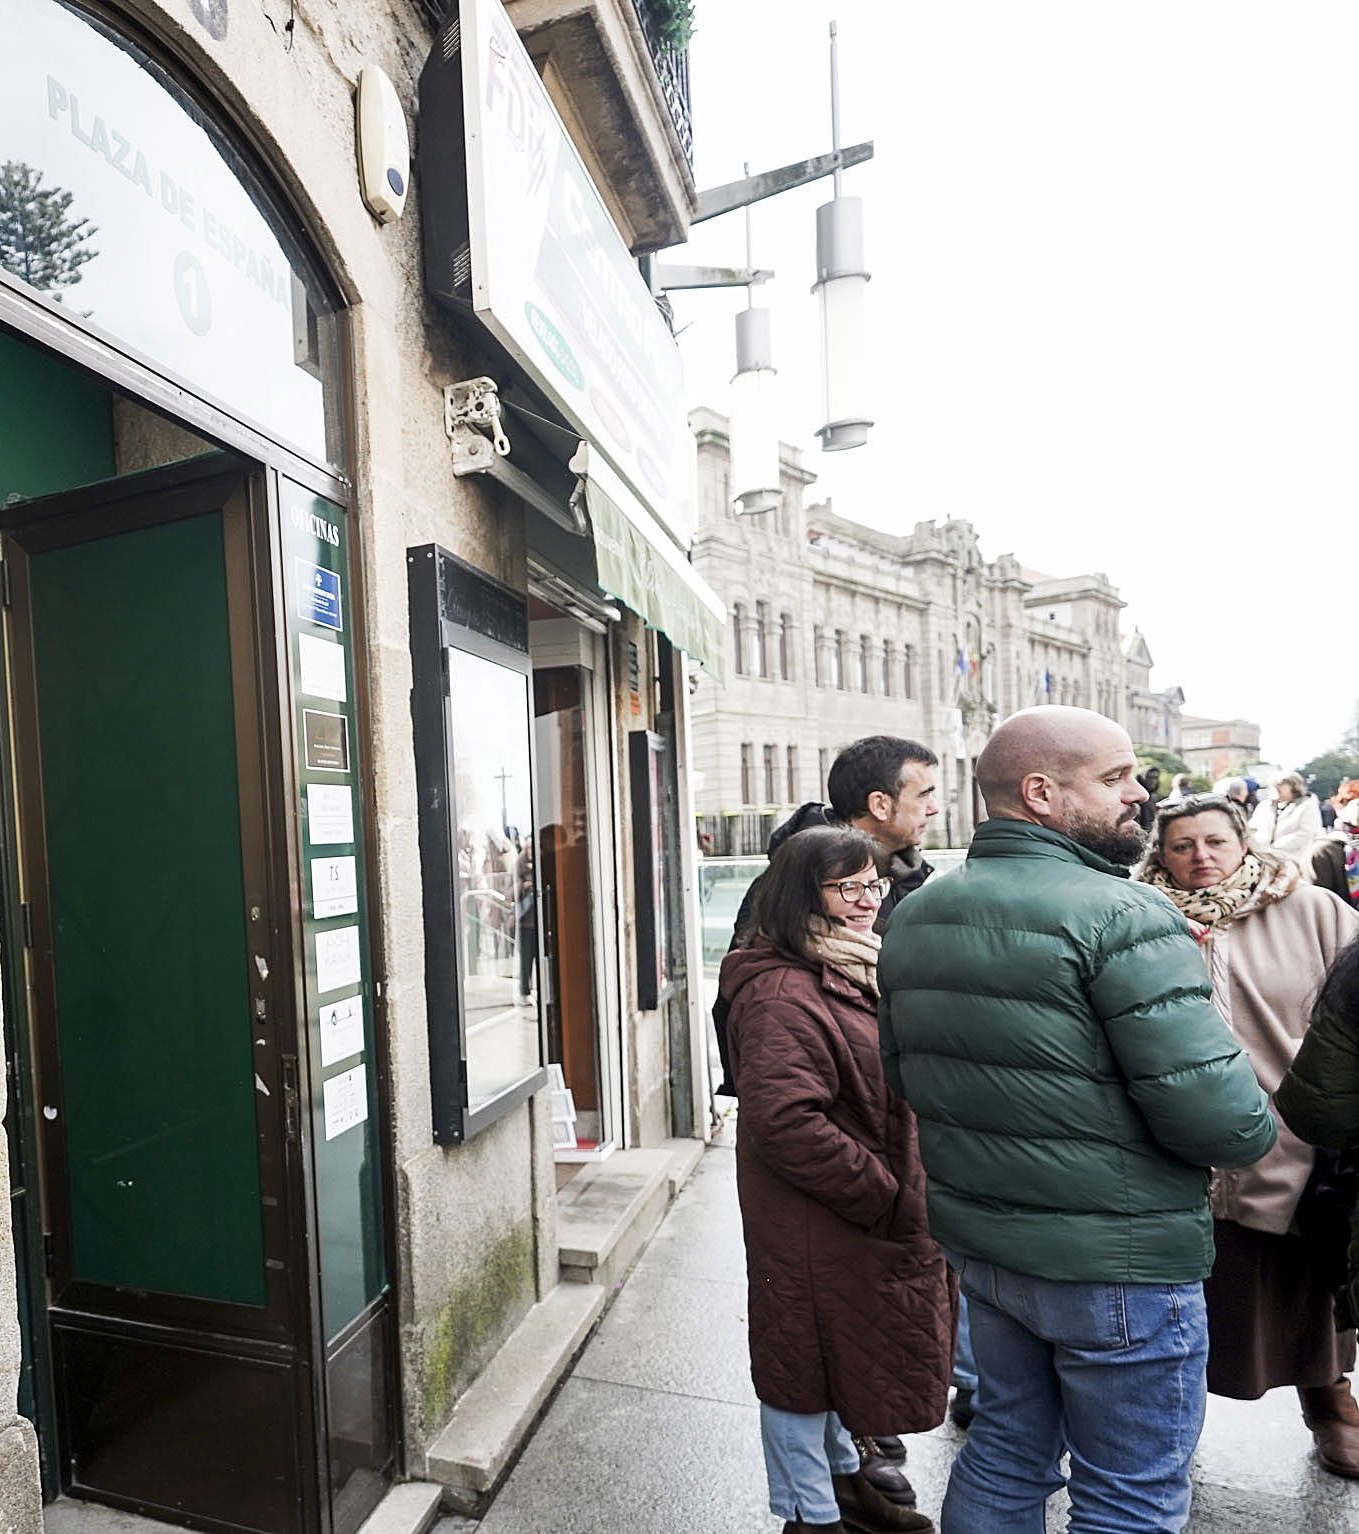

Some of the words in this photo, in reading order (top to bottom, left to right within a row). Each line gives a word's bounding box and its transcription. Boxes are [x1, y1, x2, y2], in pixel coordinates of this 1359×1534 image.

[46, 73, 153, 198] PLAZA
[160, 168, 196, 232] DE
[202, 206, 291, 312] ESPAÑA
[183, 265, 201, 316] 1
[290, 504, 340, 548] OFICINAS
